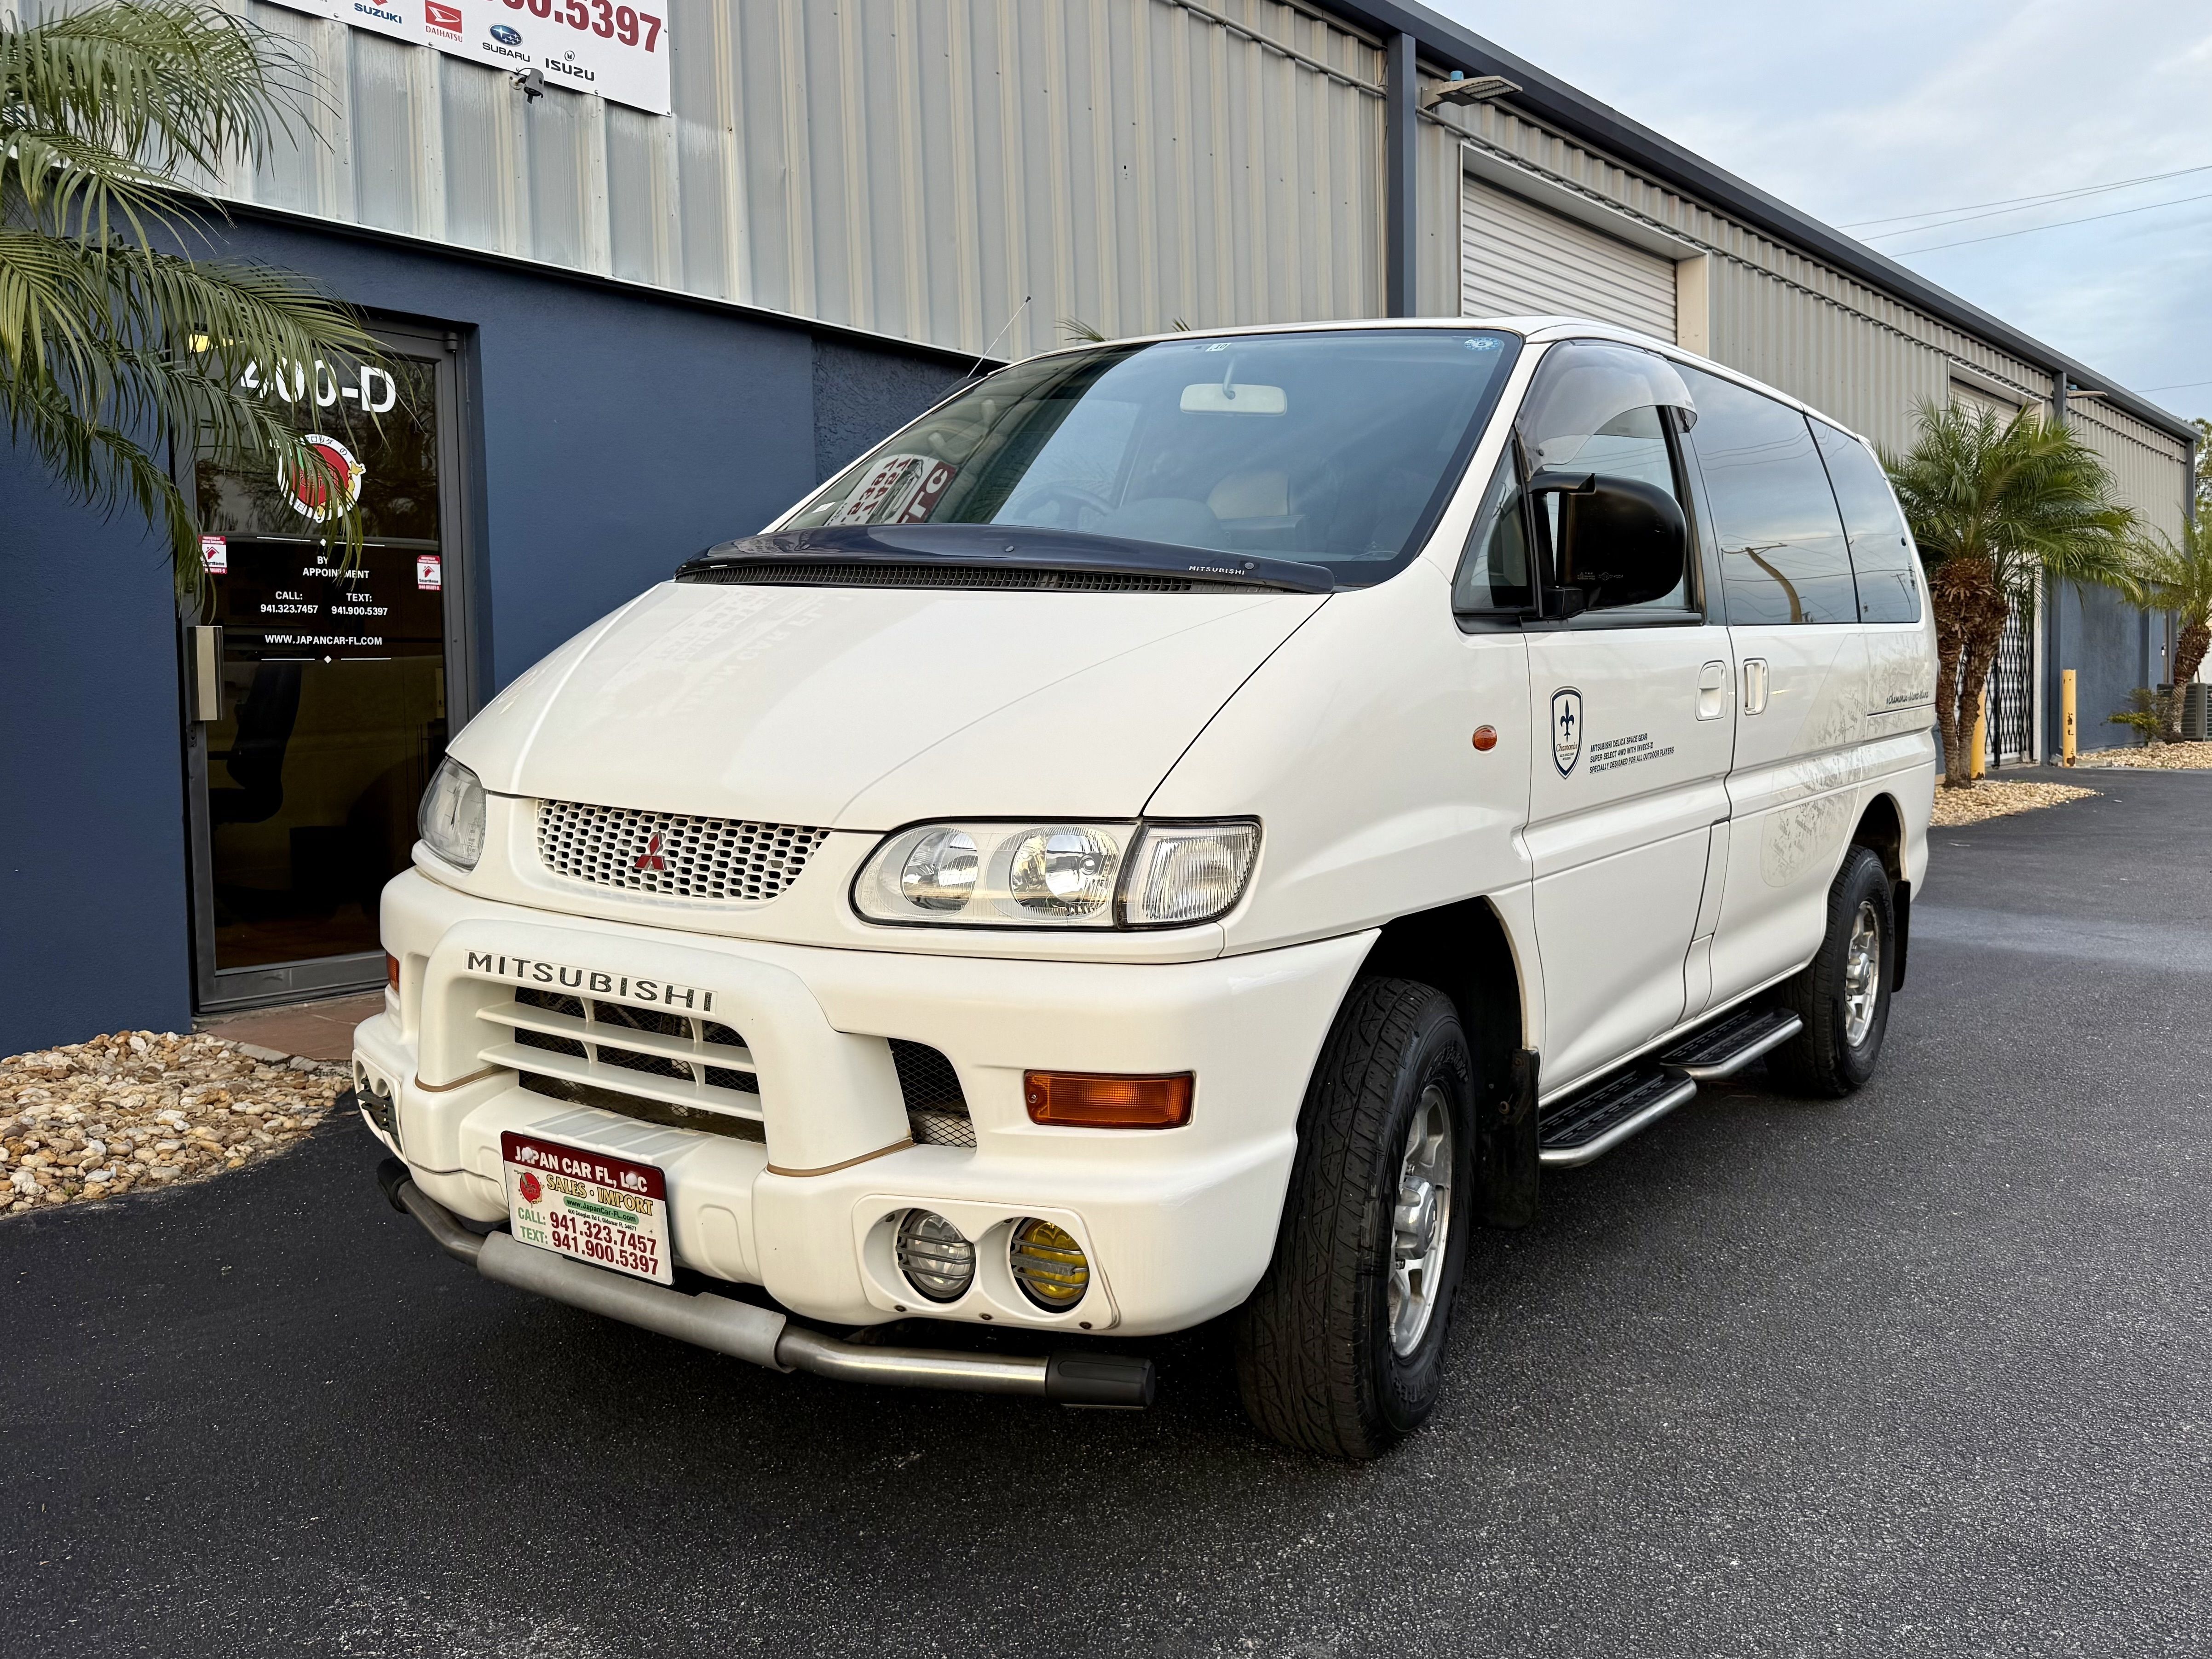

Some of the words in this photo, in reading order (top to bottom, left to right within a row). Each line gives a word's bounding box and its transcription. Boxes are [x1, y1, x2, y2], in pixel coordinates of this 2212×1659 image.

[354, 3, 402, 23] SUZUKI
[426, 25, 463, 42] DAIHATSU
[482, 42, 530, 62] SUBARU
[545, 58, 594, 81] ISUZU
[317, 556, 328, 565] BY
[303, 567, 369, 579] APPOINMENT
[1189, 565, 1245, 575] MITSUBISHI
[275, 591, 303, 600] CALL:
[346, 593, 372, 602] TEXT:
[260, 604, 318, 614] 941.323.7457
[331, 606, 388, 616] 941.900.5397
[265, 634, 382, 645] WWW.JAPANCAR-FL.COM
[1590, 740, 1613, 752] MITSUBISHI
[1603, 750, 1617, 760] SELECT
[1627, 745, 1636, 754] WITH
[1610, 758, 1628, 768] DESIGNED
[467, 951, 713, 1012] MITSUBISHI
[562, 1157, 592, 1180] CAR
[595, 1165, 617, 1188] FL,
[546, 1174, 588, 1198] SALES
[597, 1187, 653, 1216] IMPORT
[566, 1199, 636, 1222] www.JapanCar-FL.com
[518, 1207, 546, 1225] CALL:
[550, 1211, 657, 1256] 941.323.7457
[520, 1226, 548, 1244] TEXT:
[552, 1230, 658, 1275] 941.900.5397
